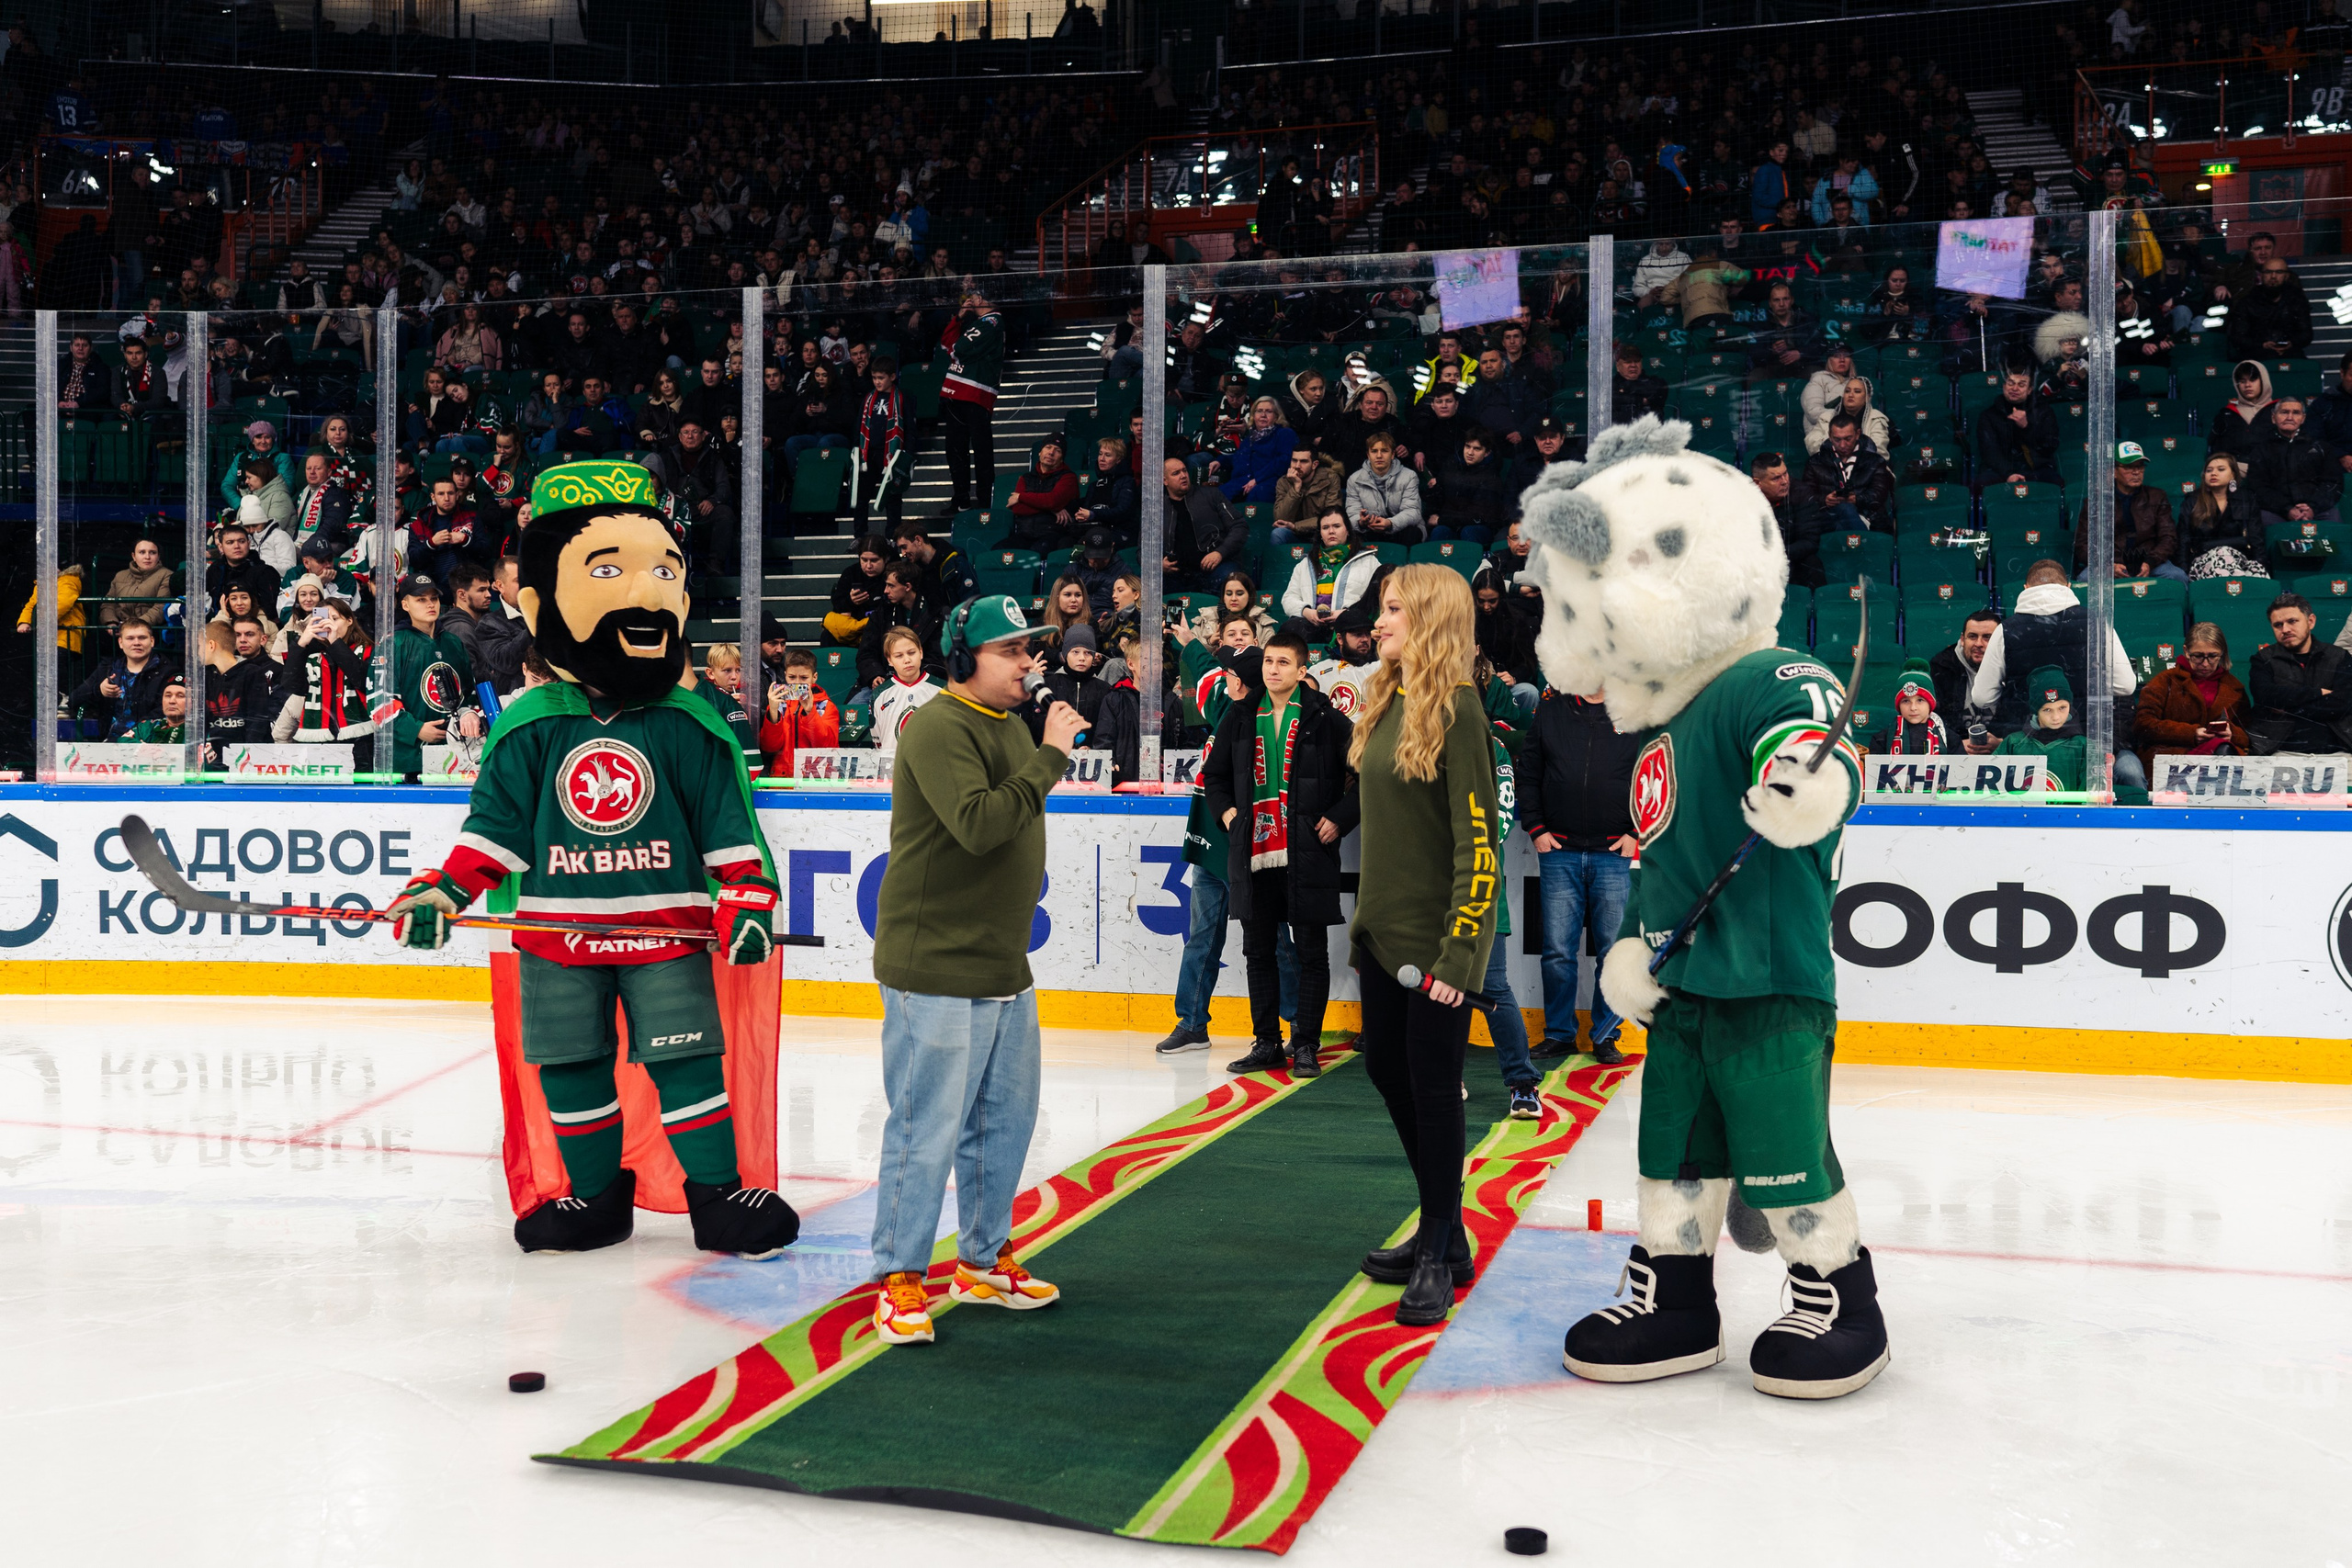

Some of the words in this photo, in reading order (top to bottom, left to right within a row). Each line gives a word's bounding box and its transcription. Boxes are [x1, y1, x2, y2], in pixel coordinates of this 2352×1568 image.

[2311, 86, 2343, 116] 9B
[58, 104, 77, 127] 13
[61, 169, 90, 195] 6A
[1163, 166, 1190, 193] 7A
[304, 479, 331, 529] КАЗАНЬ
[316, 538, 329, 550] 47
[84, 763, 176, 776] TATNEFT
[254, 764, 344, 776] TATNEFT
[801, 756, 893, 787] KHL.R
[1059, 758, 1102, 785] RU
[1172, 758, 1199, 784] K
[1876, 763, 2036, 795] KHL.RU
[2165, 764, 2336, 798] KHL.RU
[572, 840, 644, 852] KAZAN
[1185, 830, 1212, 851] NEFT
[93, 827, 413, 883] САДОВОЕ
[716, 888, 773, 906] RUE
[98, 888, 375, 947] КОЛЬЦО
[1829, 882, 2227, 979] ОФФ
[585, 936, 682, 954] TATNEFT
[650, 1032, 704, 1048] CCM
[1743, 1171, 1807, 1187] BAUER
